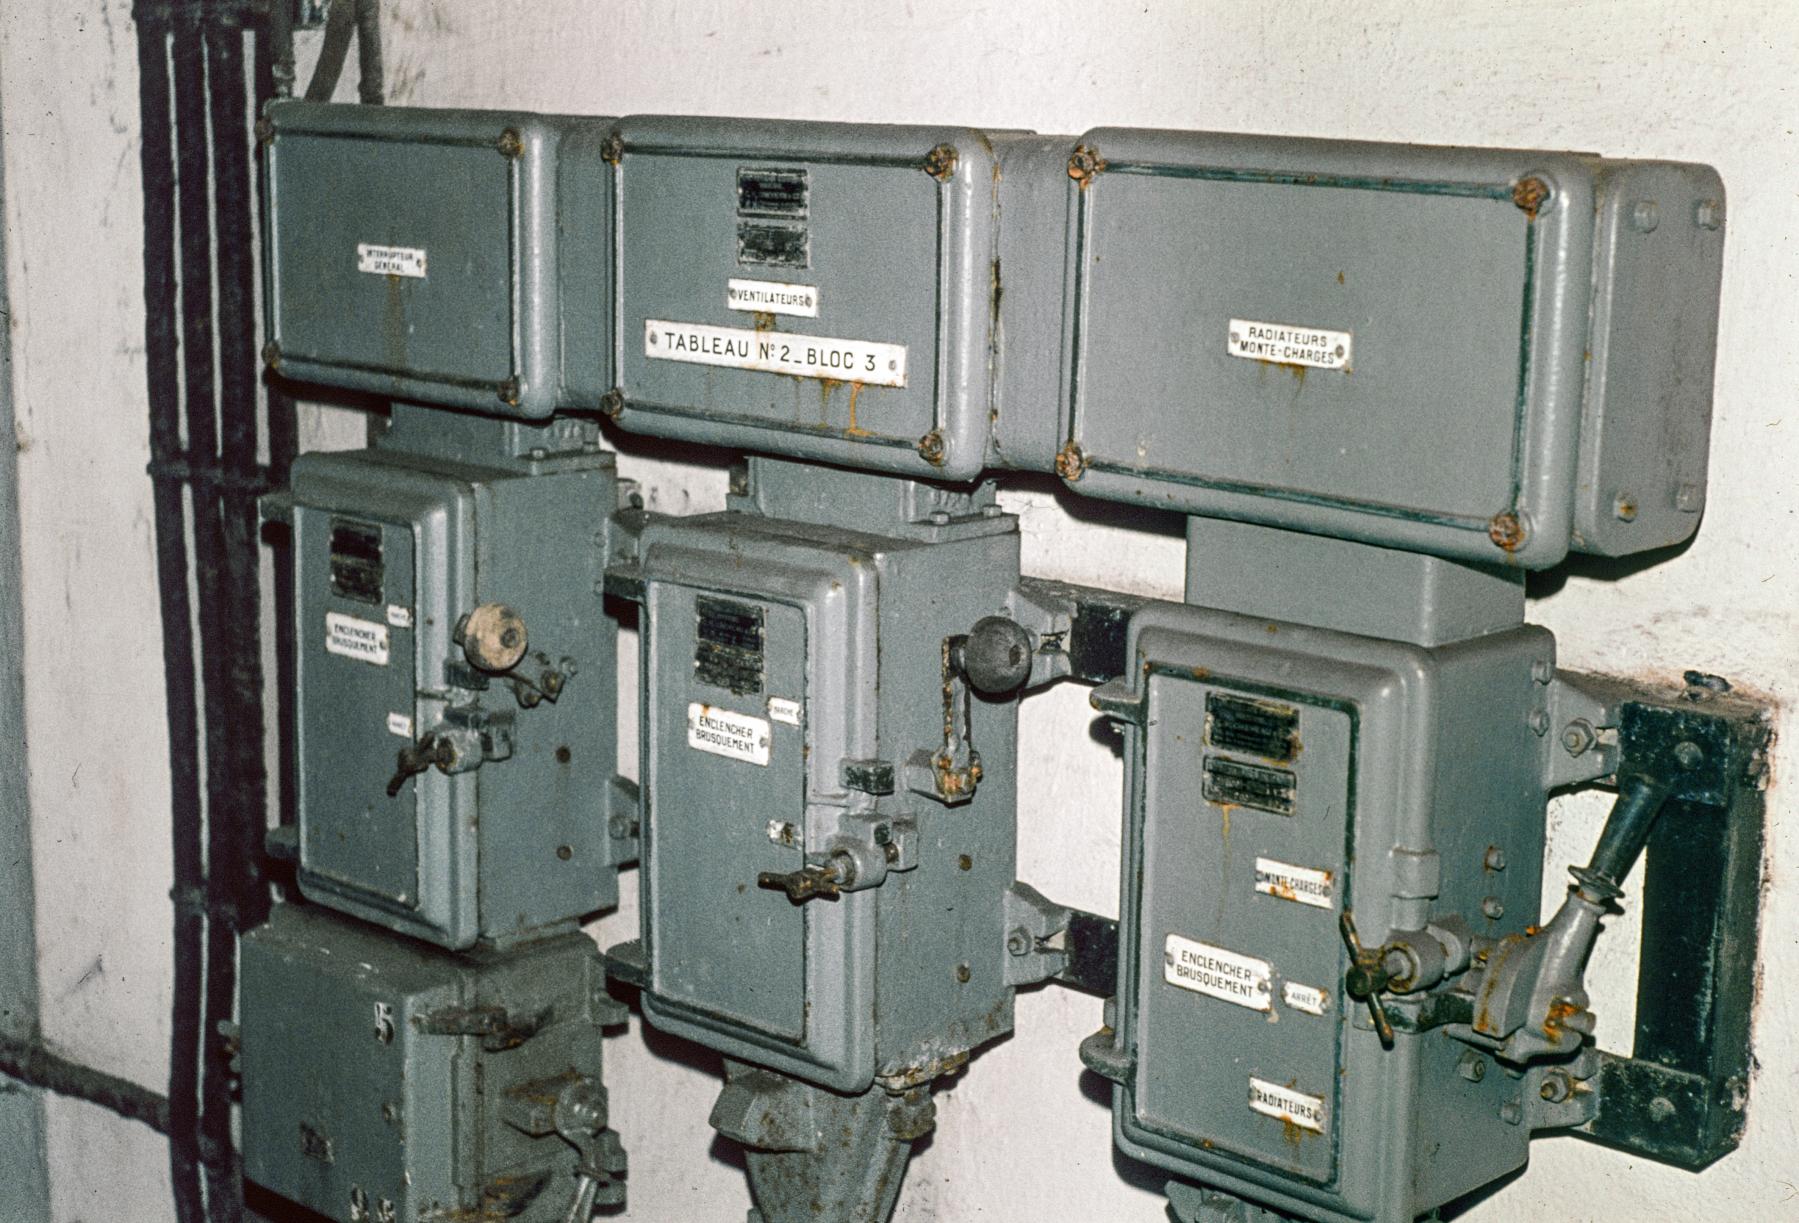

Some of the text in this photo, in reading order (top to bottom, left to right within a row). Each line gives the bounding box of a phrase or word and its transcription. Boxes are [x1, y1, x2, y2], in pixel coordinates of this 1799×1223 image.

[738, 289, 805, 306] VENTILATEURS
[1249, 327, 1327, 347] RADIATEURS
[665, 332, 748, 358] TABLEAU
[865, 354, 876, 372] 3
[1240, 341, 1334, 364] MONTE-CHARGES
[699, 716, 753, 739] ENCLENCHER
[696, 728, 754, 753] BRUSQUEMENT
[1181, 950, 1252, 982] ENCLENCHER
[1177, 964, 1253, 998] BRUSQUEMENT
[1256, 1090, 1313, 1119] RADIATEURS
